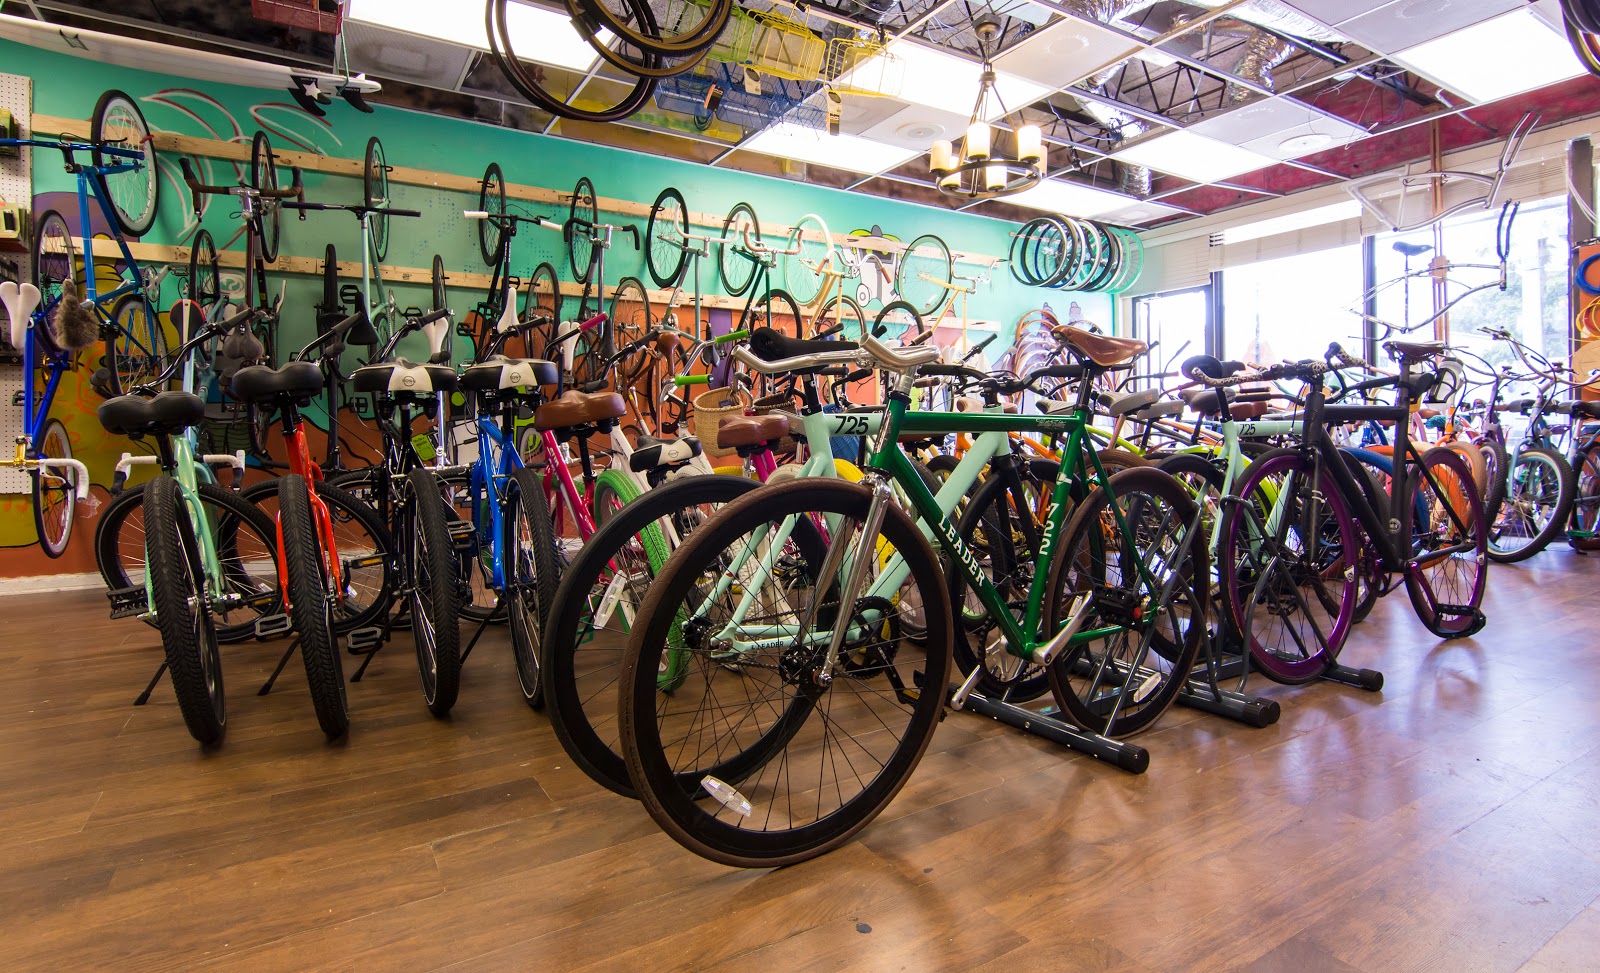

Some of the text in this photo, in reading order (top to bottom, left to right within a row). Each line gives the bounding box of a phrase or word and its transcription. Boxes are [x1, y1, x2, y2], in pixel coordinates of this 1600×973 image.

[834, 415, 869, 435] 725
[1240, 423, 1256, 436] 725
[1039, 502, 1060, 556] 722
[938, 513, 985, 587] LEADER
